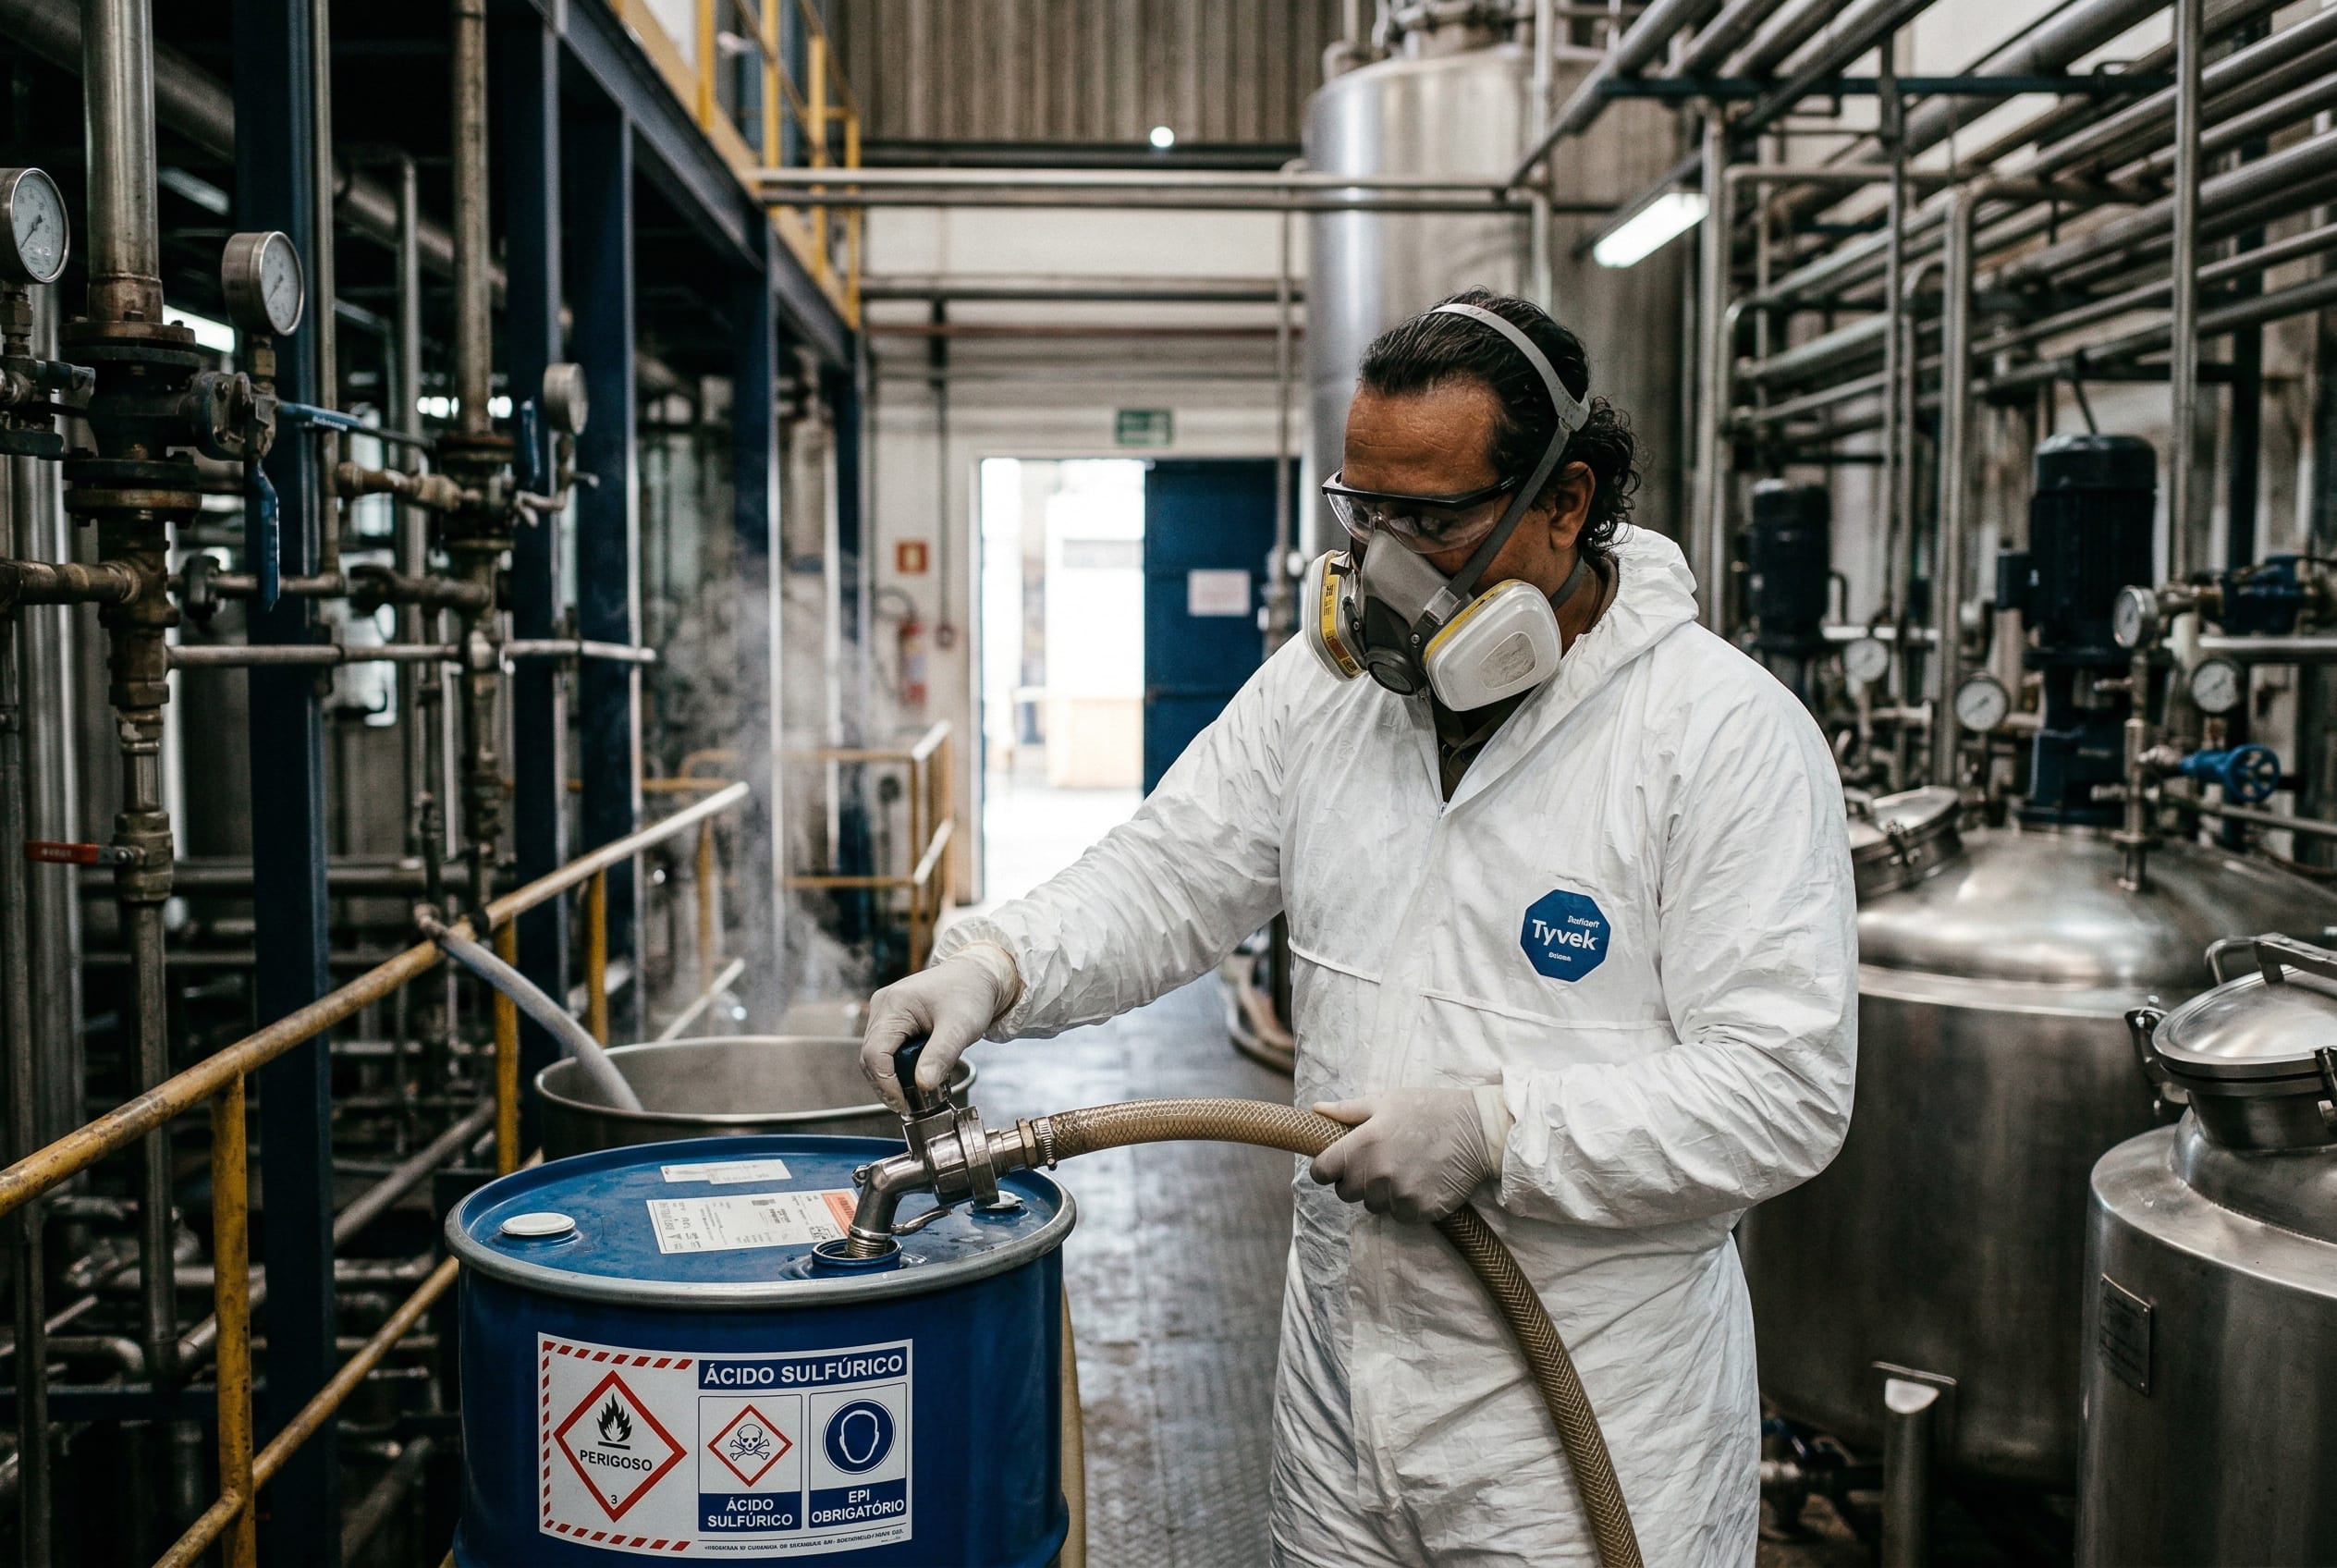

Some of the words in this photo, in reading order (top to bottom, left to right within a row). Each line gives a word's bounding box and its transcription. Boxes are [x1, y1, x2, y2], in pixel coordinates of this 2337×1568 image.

[1532, 919, 1599, 950] Tyvek
[704, 1364, 775, 1385] ÁCIDO
[781, 1355, 904, 1383] SULFÚRICO
[579, 1449, 653, 1472] PERIGOSO
[610, 1494, 618, 1505] 3
[726, 1497, 774, 1512] ÁCIDO
[848, 1489, 871, 1504] EPI
[707, 1512, 793, 1527] SULFÚRICO
[812, 1498, 905, 1524] OBRIGATÓRIO
